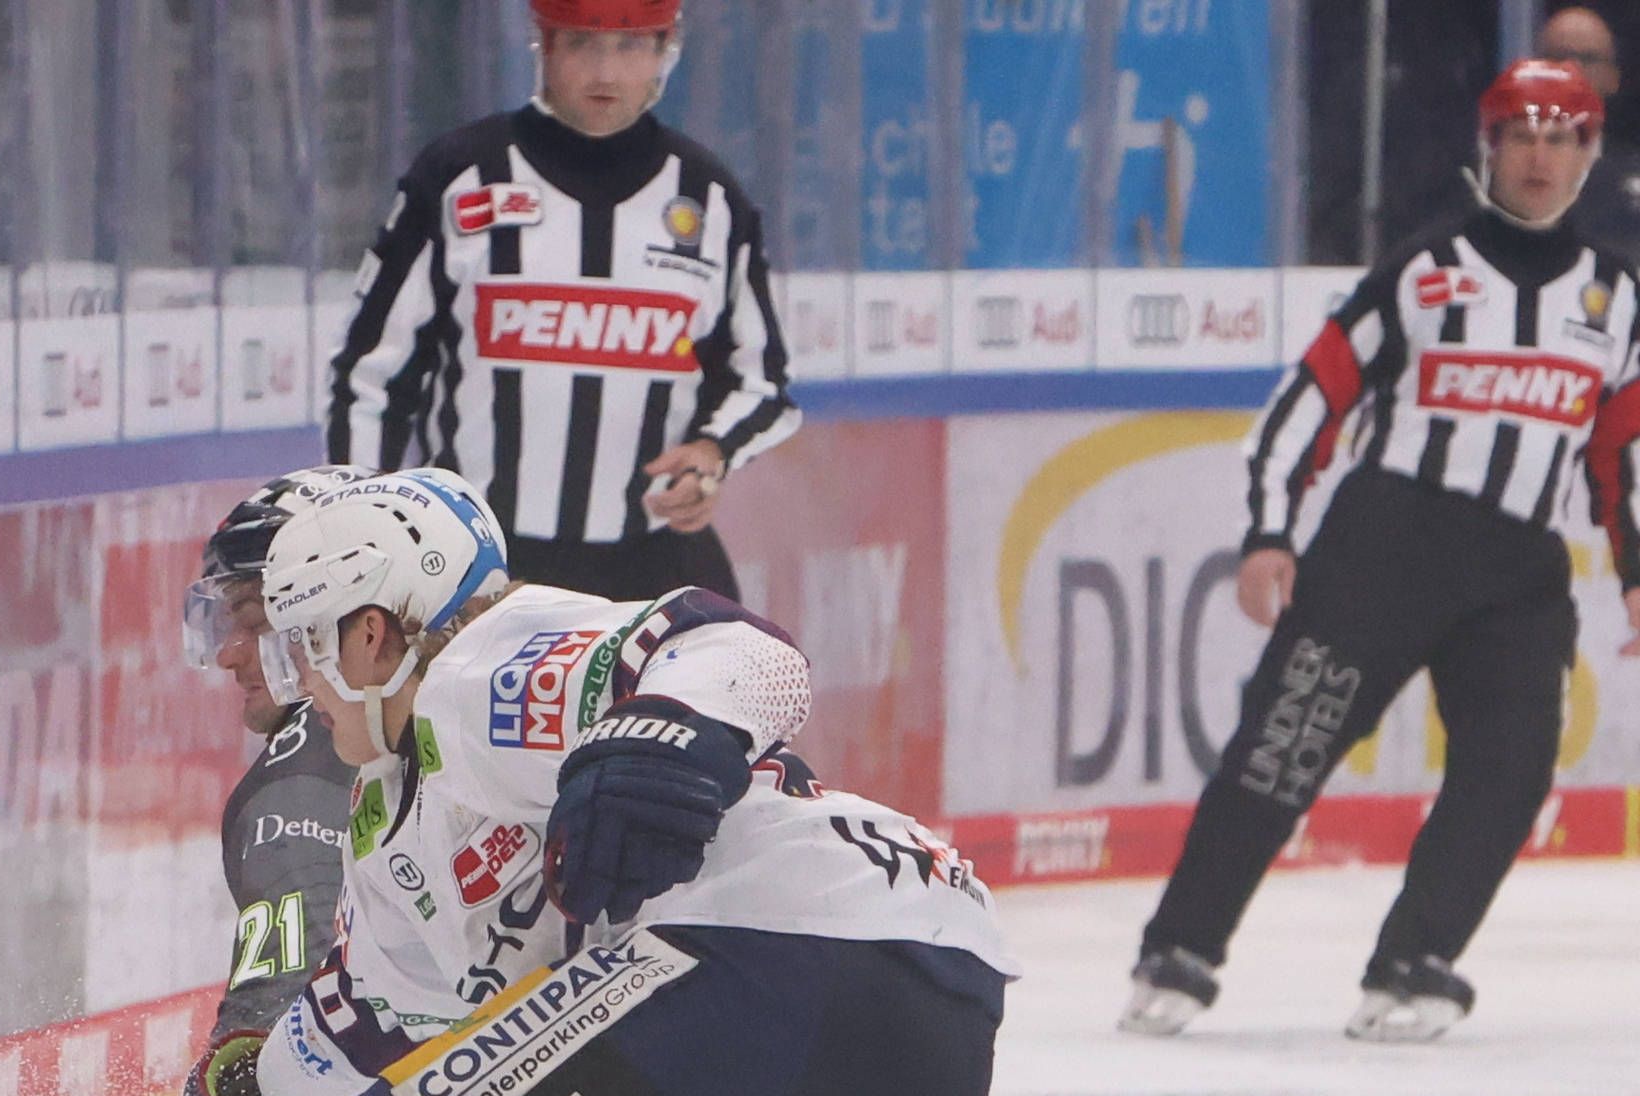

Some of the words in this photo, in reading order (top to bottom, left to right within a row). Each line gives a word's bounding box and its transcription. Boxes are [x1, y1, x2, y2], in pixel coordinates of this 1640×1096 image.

[319, 483, 431, 509] STADLER
[276, 582, 328, 613] STADLER
[491, 631, 559, 741] LIQUI
[525, 630, 592, 744] MOLY
[1239, 637, 1330, 795] LINDNER
[1277, 662, 1360, 808] HOTELS
[230, 891, 306, 992] 21
